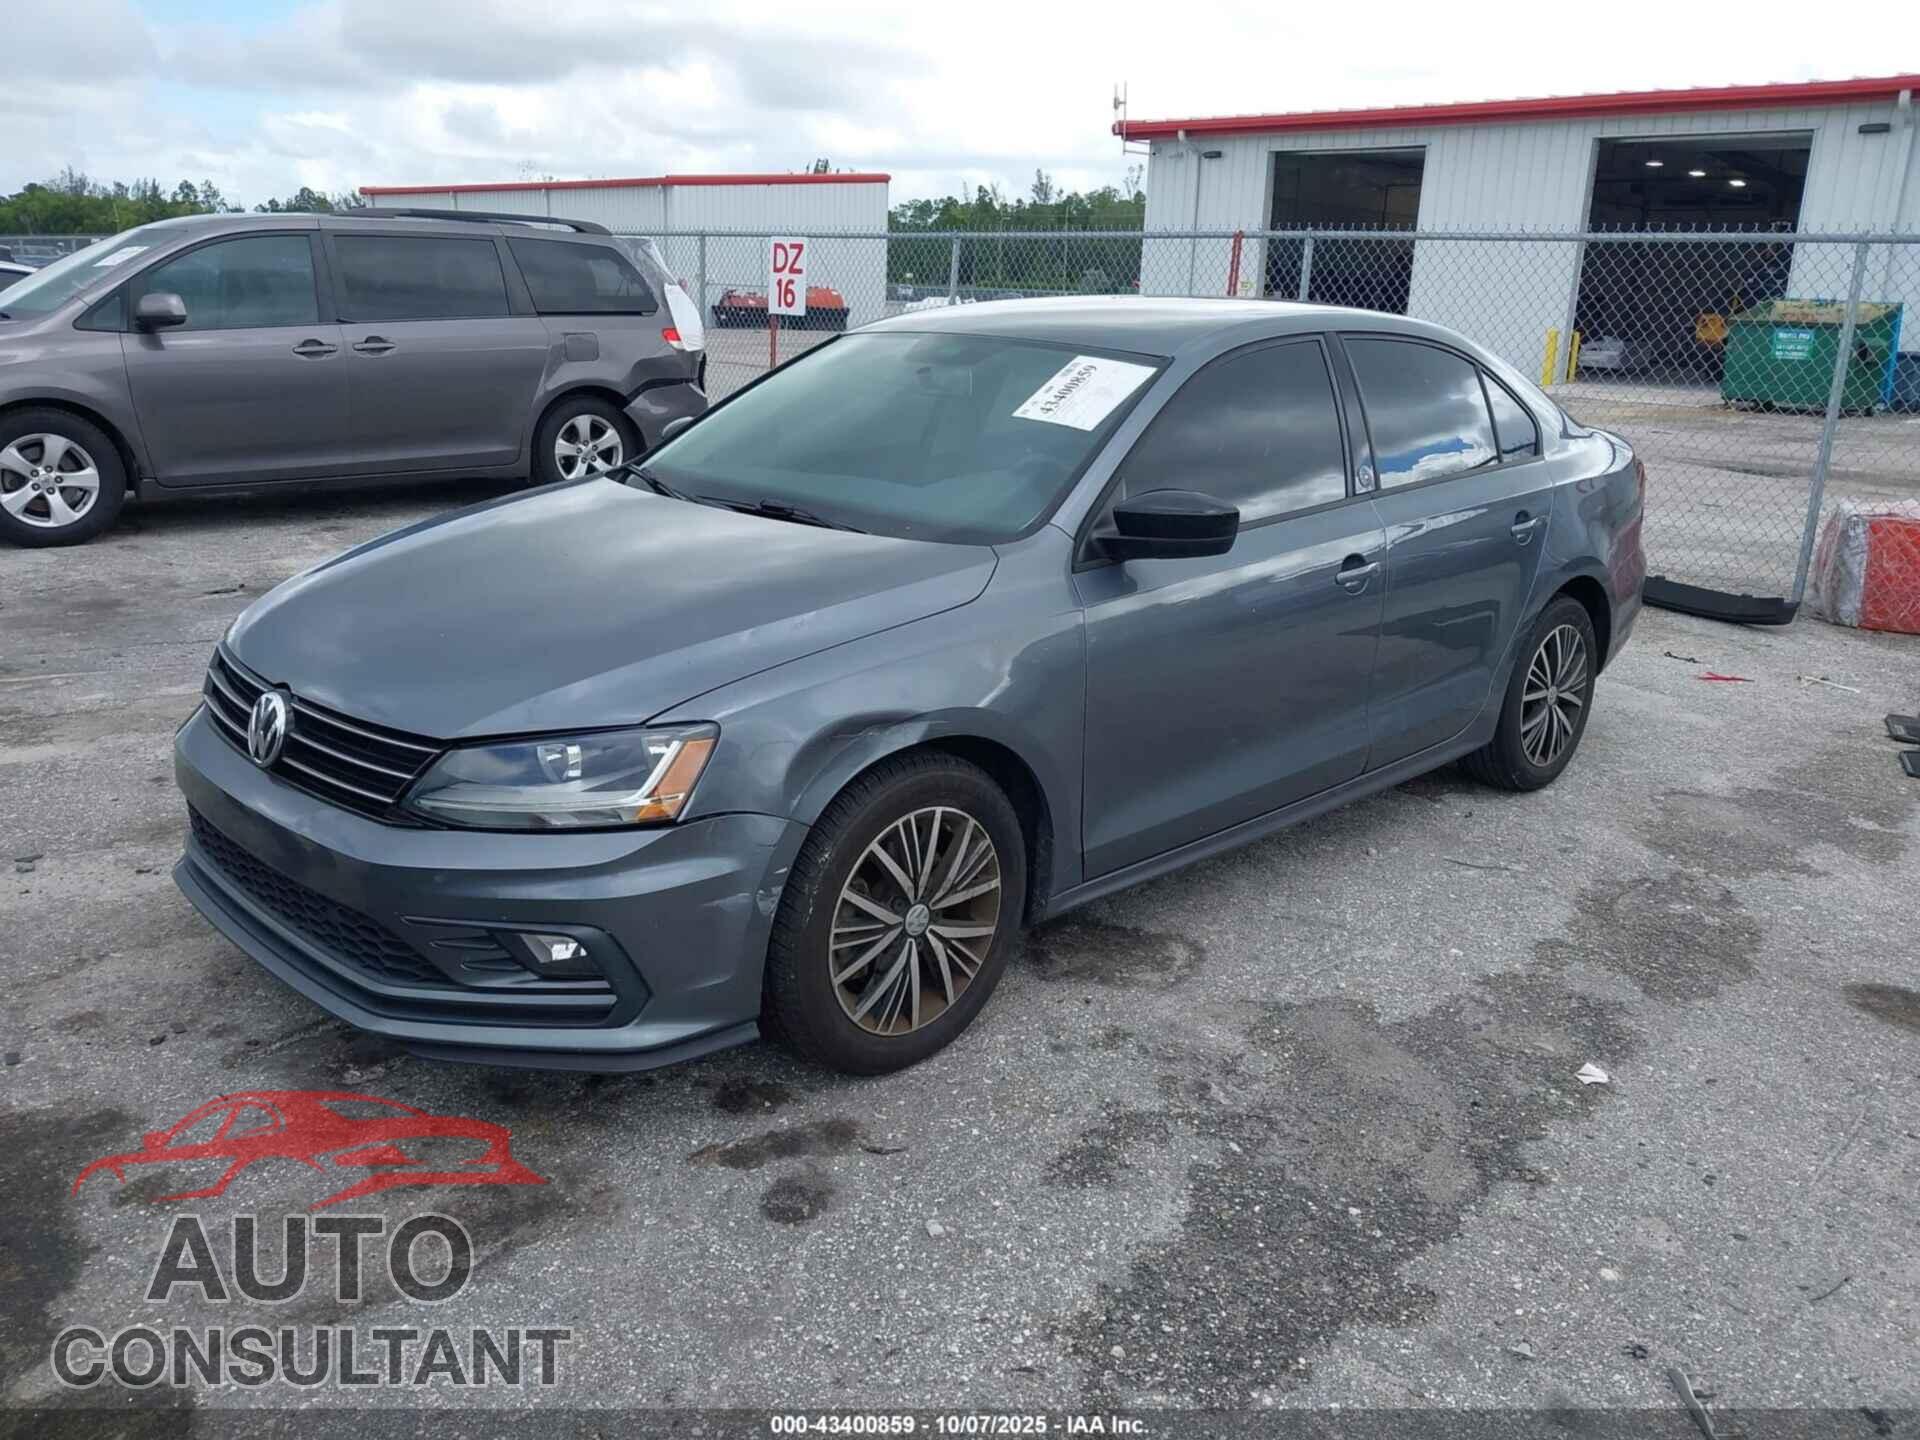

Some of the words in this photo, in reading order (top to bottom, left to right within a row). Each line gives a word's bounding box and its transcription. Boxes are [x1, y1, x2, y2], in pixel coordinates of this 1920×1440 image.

[773, 243, 804, 274] DZ
[776, 278, 796, 308] 16
[1040, 364, 1097, 415] 43400859
